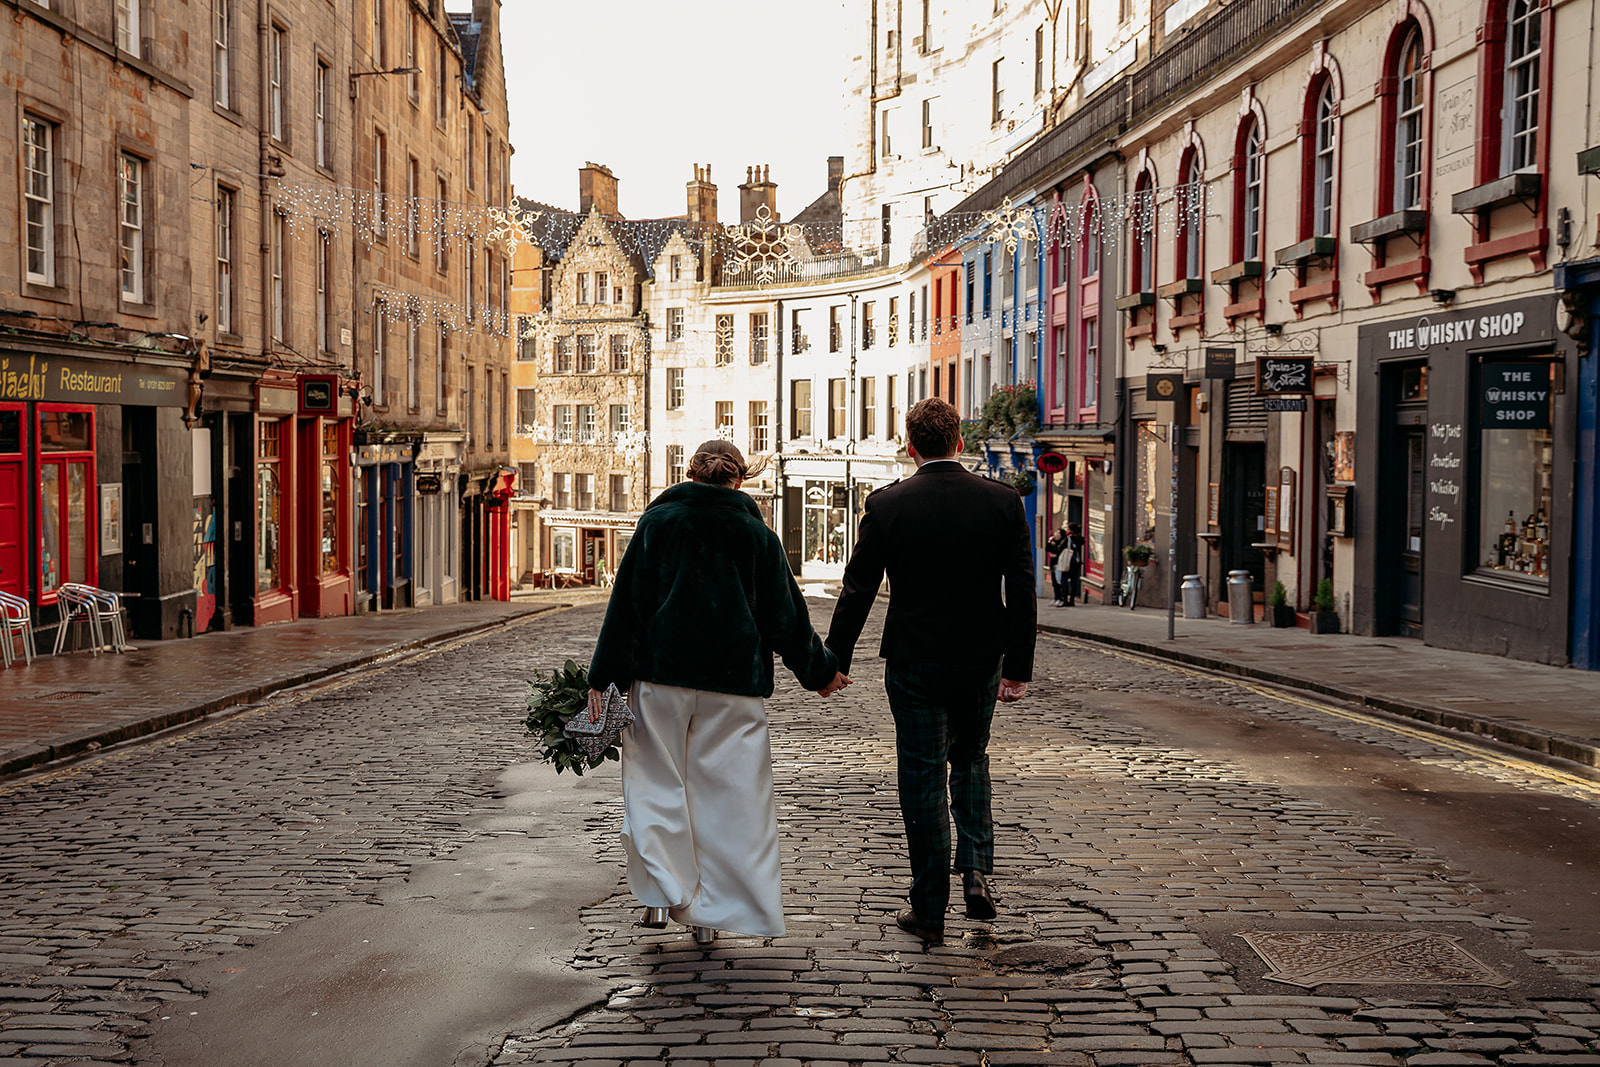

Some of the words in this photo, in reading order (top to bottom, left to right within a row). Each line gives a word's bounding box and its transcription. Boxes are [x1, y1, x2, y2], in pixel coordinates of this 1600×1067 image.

[1388, 328, 1414, 350] THE
[1416, 316, 1476, 350] WHISKY
[1479, 311, 1524, 339] SHOP
[0, 353, 48, 400] iachi
[60, 367, 122, 393] Restaurant
[1502, 371, 1532, 382] THE
[1486, 387, 1547, 404] WHISKY
[1264, 400, 1306, 411] RESTAURANT
[1496, 409, 1536, 421] SHOP
[1431, 422, 1446, 438] Not
[1430, 452, 1461, 469] Another
[1430, 479, 1460, 505] Whisky
